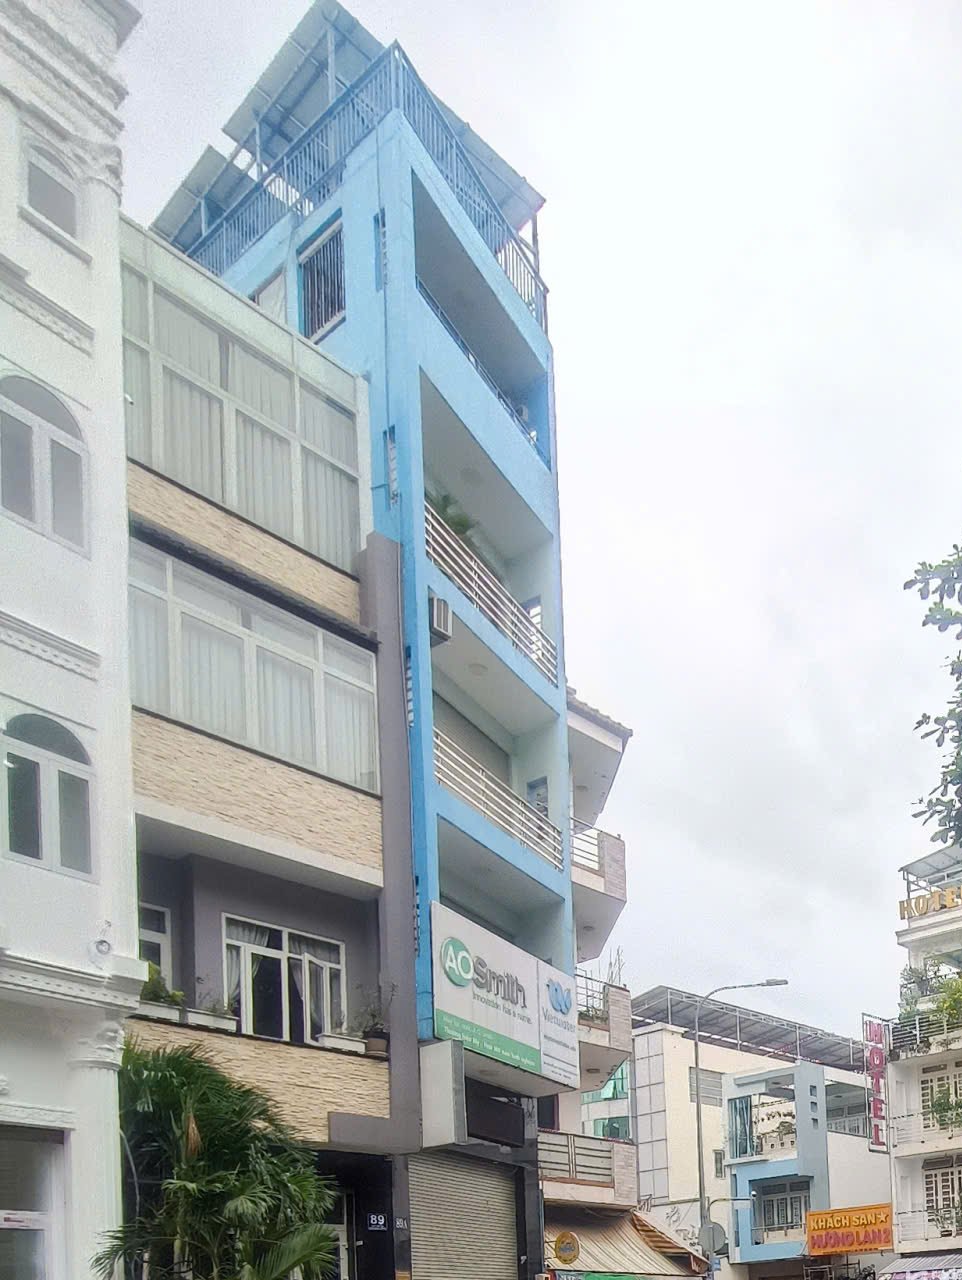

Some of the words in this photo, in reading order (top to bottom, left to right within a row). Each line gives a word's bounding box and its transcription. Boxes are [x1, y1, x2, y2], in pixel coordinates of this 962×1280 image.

[445, 945, 475, 980] AO
[473, 955, 527, 1009] Smith
[865, 1020, 887, 1147] HOTEL
[370, 1214, 385, 1225] 89
[811, 1214, 850, 1231] KHÁCH
[852, 1212, 877, 1228] SẠN
